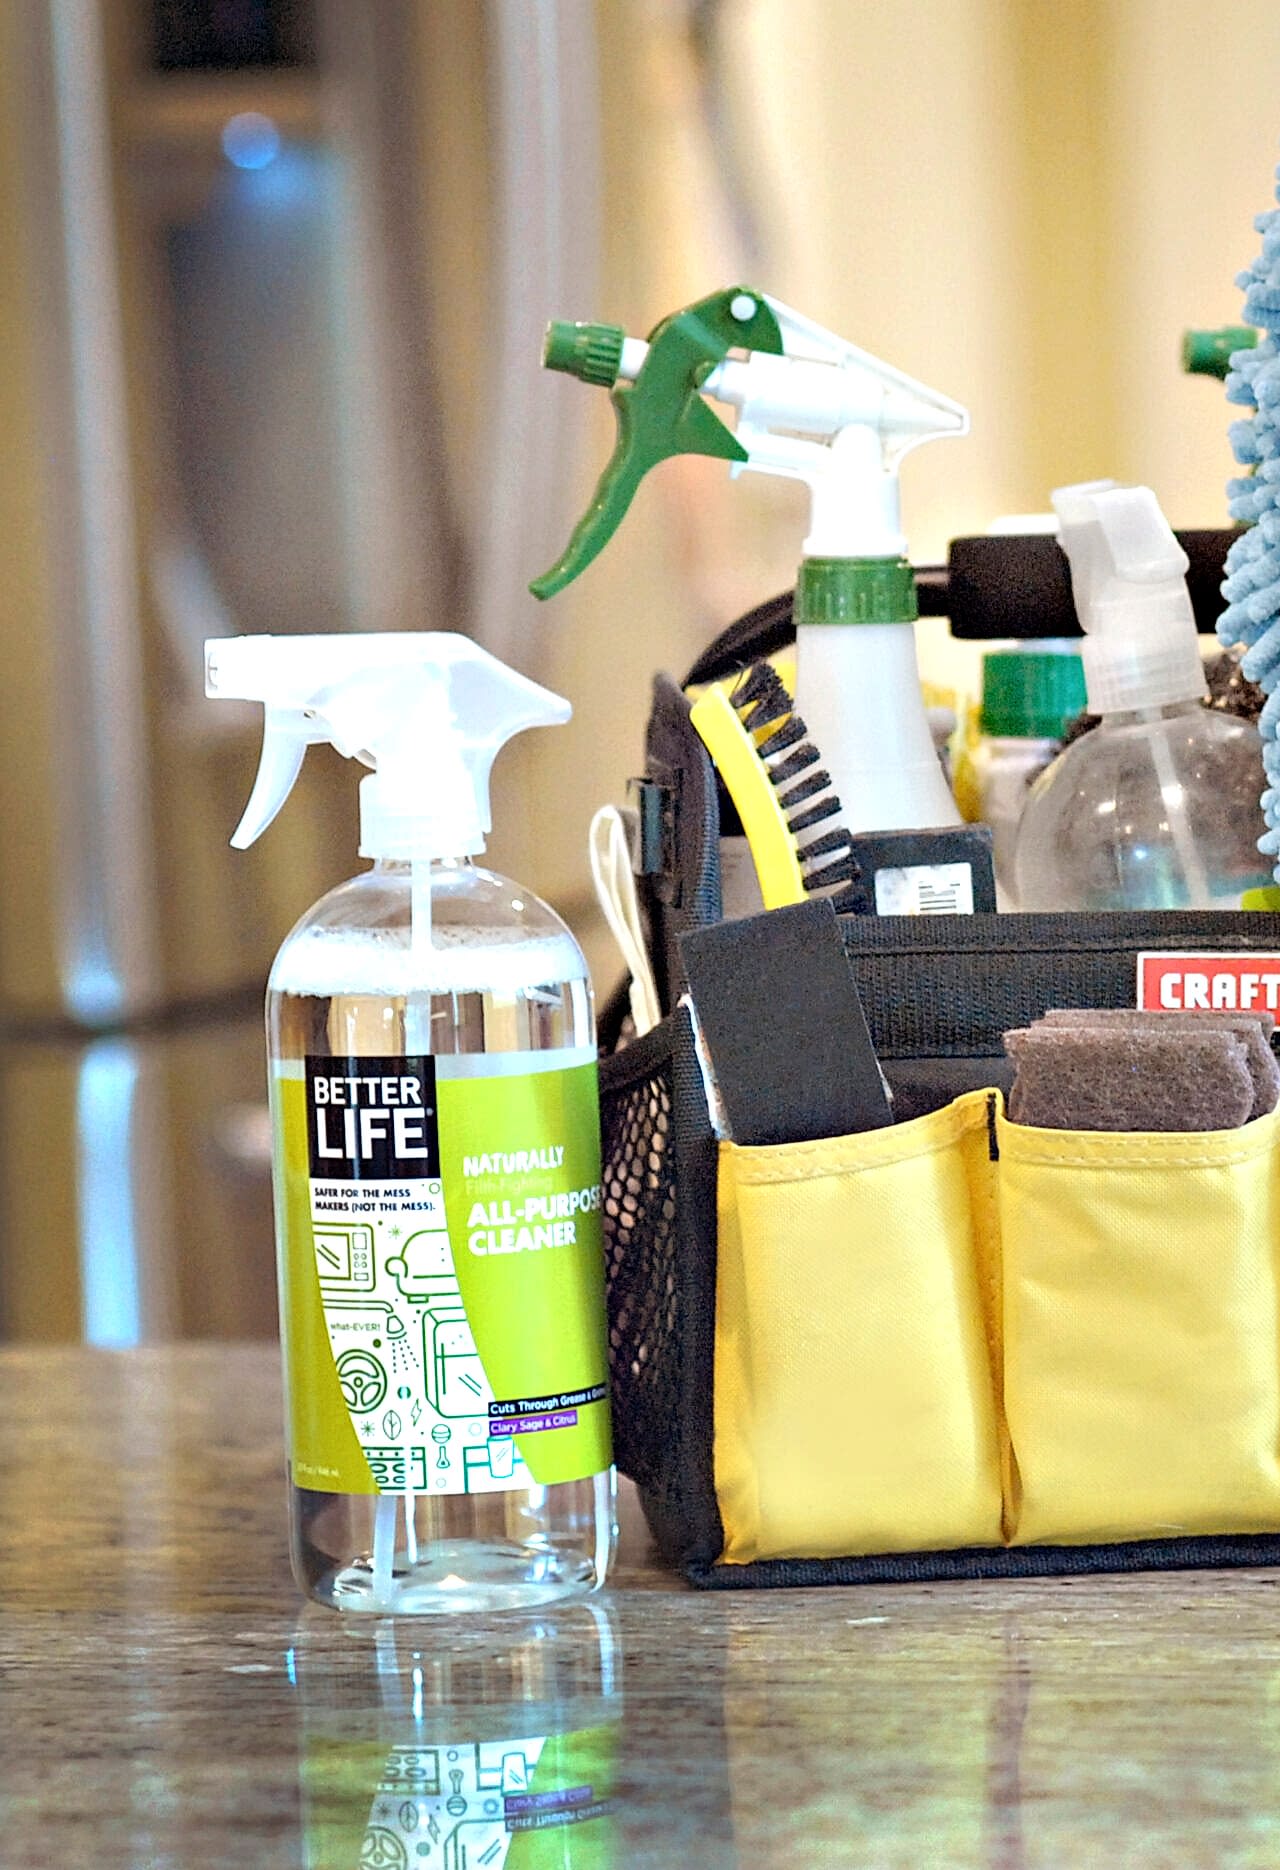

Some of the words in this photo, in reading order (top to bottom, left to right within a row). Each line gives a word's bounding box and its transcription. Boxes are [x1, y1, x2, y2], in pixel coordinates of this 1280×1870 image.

[314, 1076, 421, 1105] BETTER
[316, 1107, 428, 1159] LIFE
[462, 1145, 564, 1178] NATURALLY
[314, 1187, 338, 1197] SAFER
[340, 1188, 359, 1198] FOR
[362, 1189, 380, 1198] THE
[383, 1189, 411, 1198] MESS
[314, 1201, 350, 1212] MAKERS
[351, 1202, 376, 1213] (NOT
[379, 1203, 398, 1212] THE
[467, 1221, 577, 1257] CLEANER
[490, 1403, 516, 1415] Cuts
[518, 1398, 559, 1411] Through
[560, 1394, 586, 1406] Grease
[490, 1422, 518, 1434] Clary
[519, 1418, 543, 1431] Sage
[553, 1414, 576, 1425] Citrus
